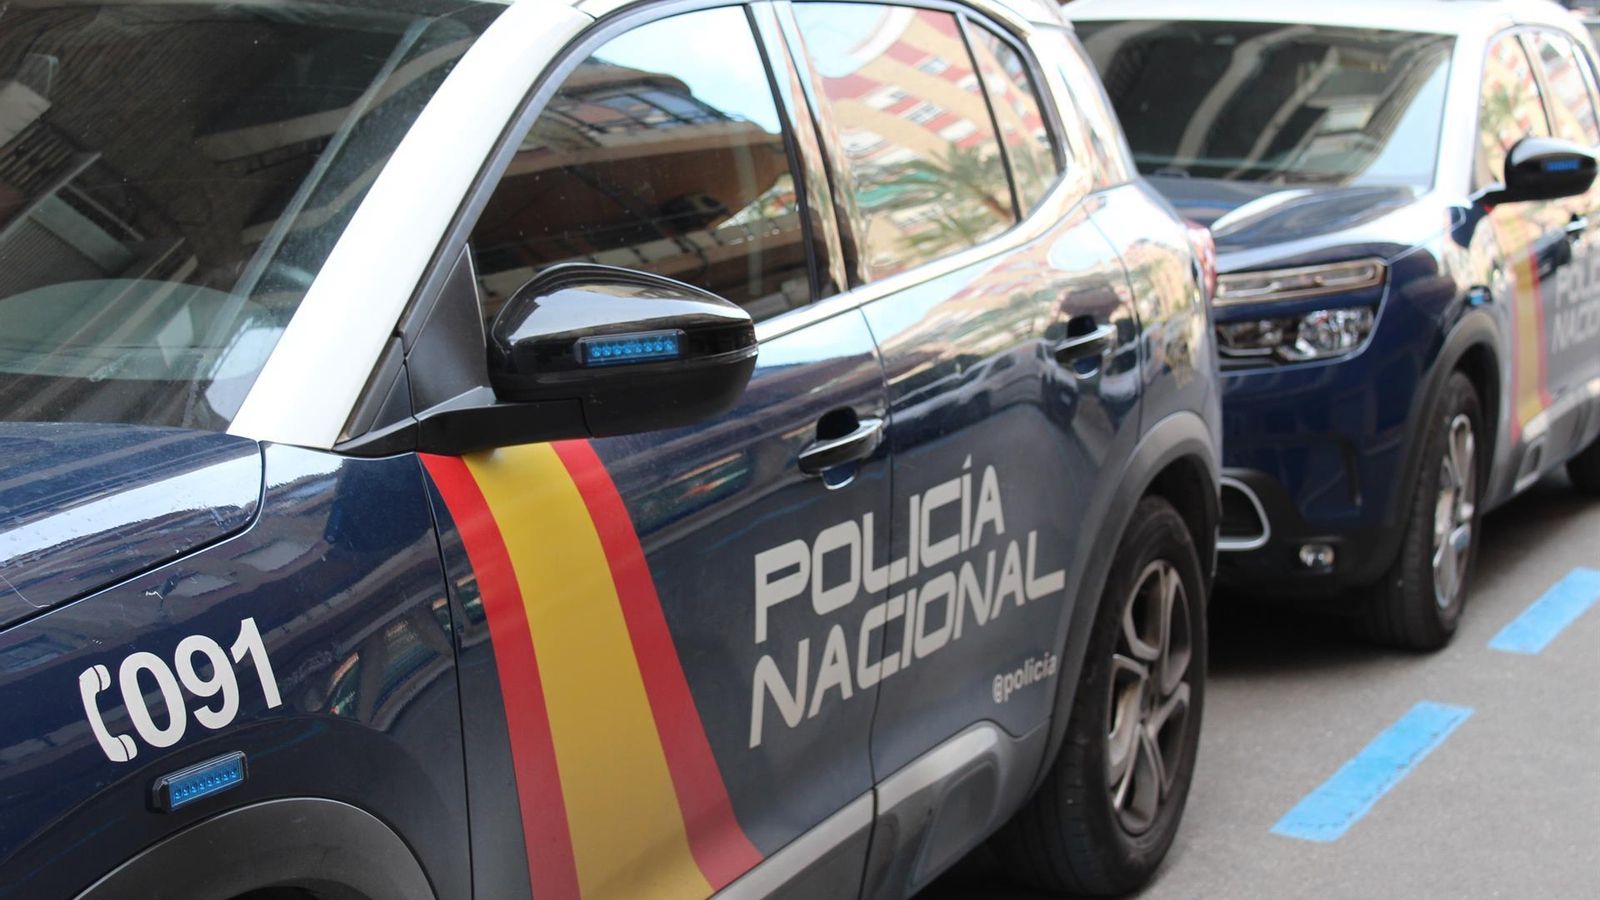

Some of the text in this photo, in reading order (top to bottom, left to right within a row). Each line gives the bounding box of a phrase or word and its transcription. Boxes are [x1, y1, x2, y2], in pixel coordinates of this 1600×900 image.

[749, 530, 1065, 749] NACIONAL
[755, 454, 1005, 644] POLICÍA
[119, 616, 283, 748] 091
